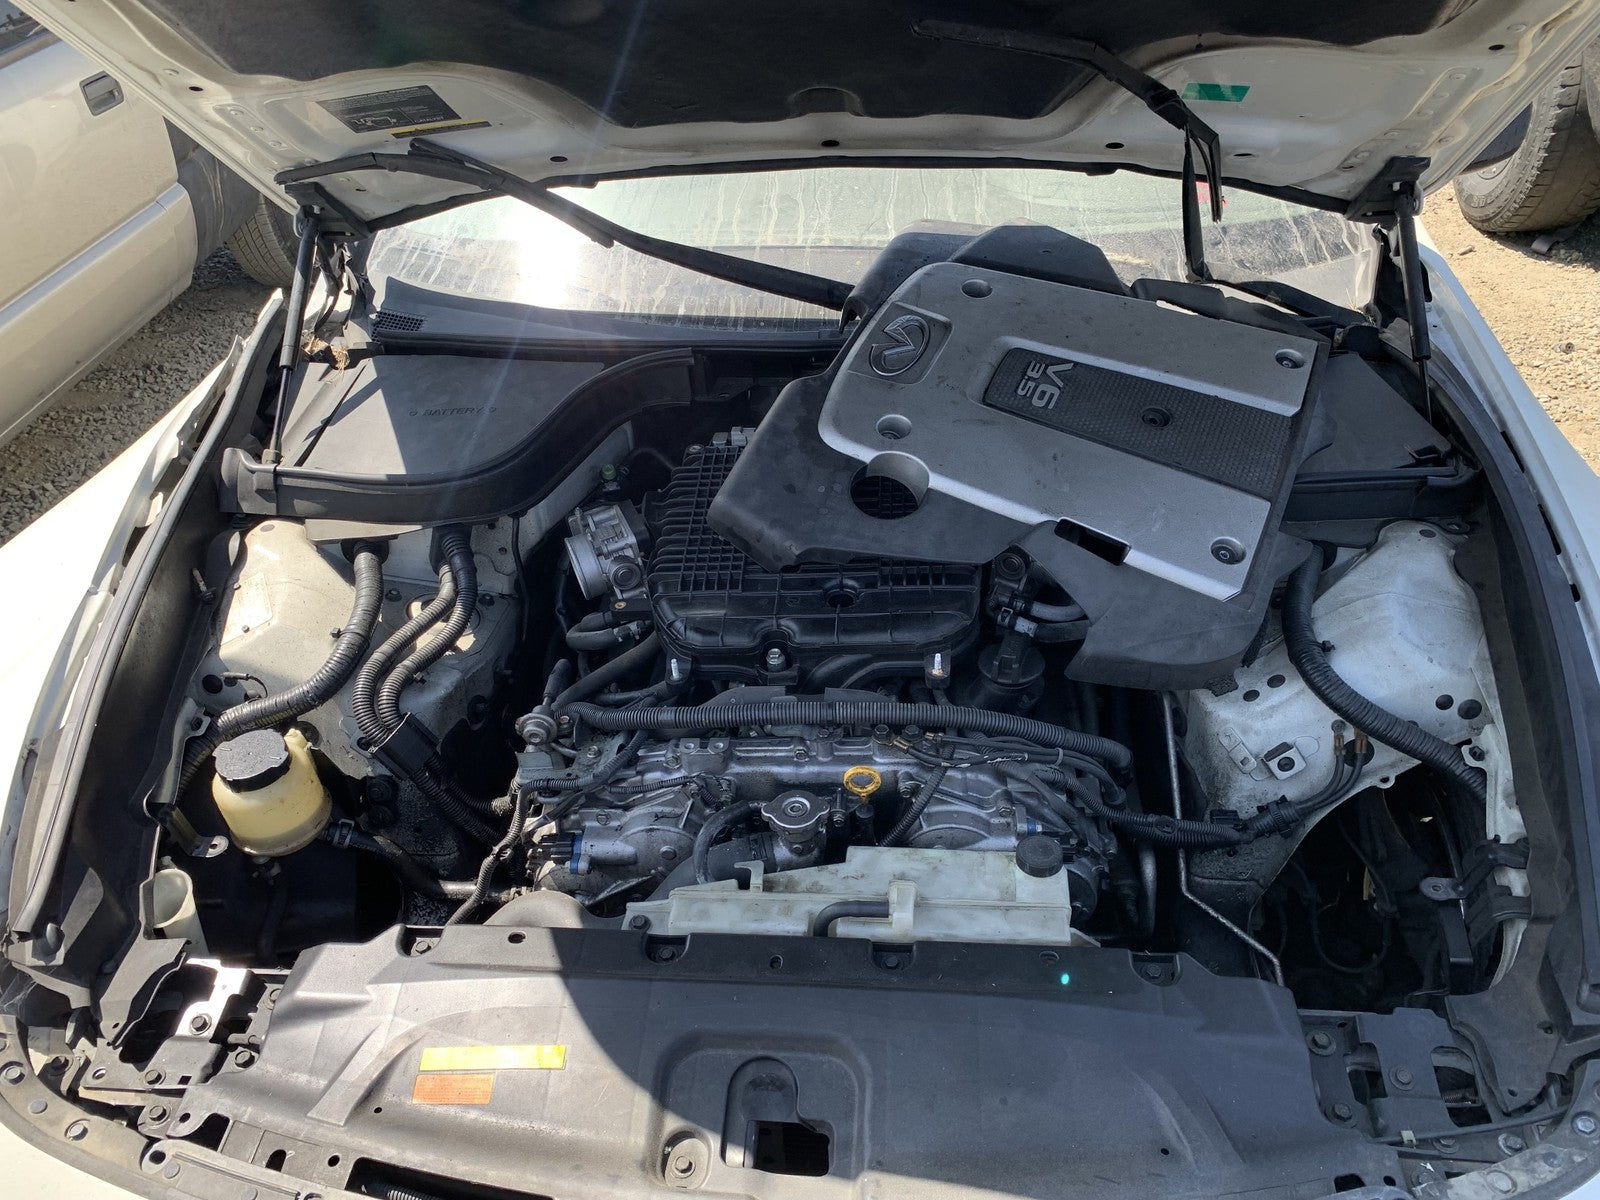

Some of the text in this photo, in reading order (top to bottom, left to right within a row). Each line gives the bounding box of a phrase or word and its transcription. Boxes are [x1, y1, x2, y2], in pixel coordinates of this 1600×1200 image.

[1016, 360, 1046, 397] 3.5
[1031, 362, 1075, 410] V6
[422, 406, 484, 417] BATTERY
